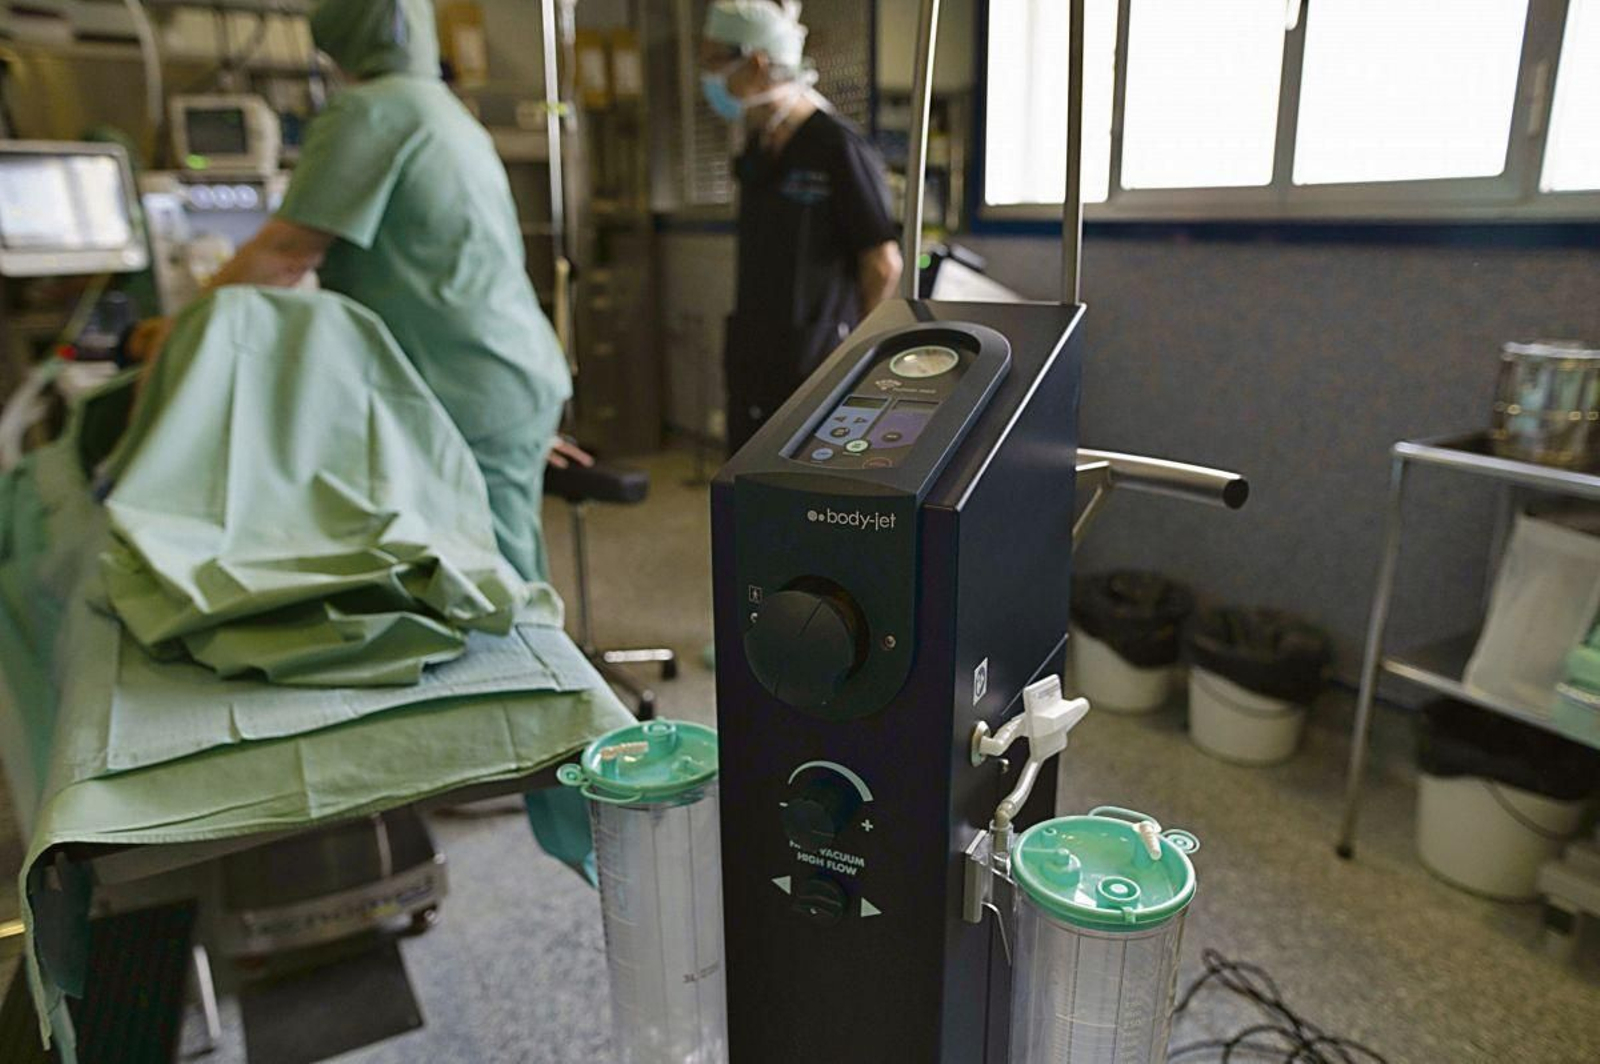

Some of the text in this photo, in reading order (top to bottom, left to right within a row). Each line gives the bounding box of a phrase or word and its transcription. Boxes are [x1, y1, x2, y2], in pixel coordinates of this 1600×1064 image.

[827, 508, 896, 531] body-jet
[797, 851, 857, 875] HIGH FLOW
[819, 848, 865, 868] VACUUM
